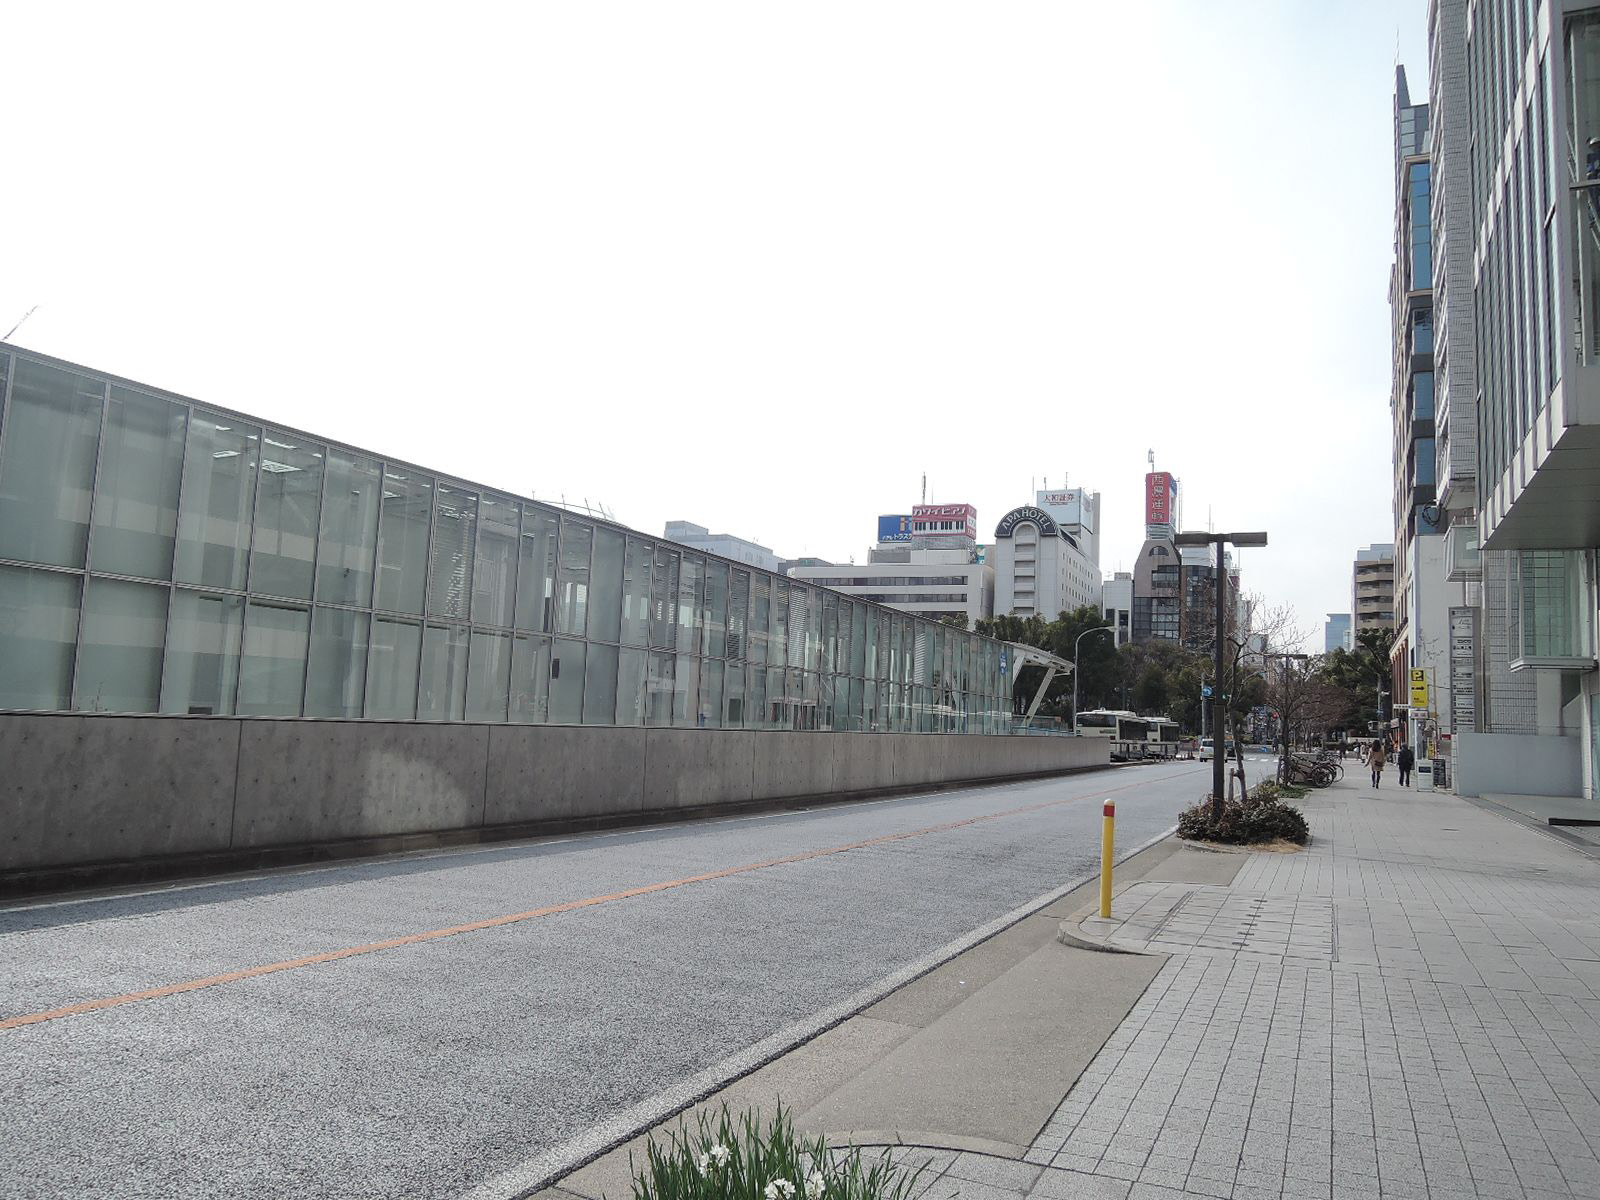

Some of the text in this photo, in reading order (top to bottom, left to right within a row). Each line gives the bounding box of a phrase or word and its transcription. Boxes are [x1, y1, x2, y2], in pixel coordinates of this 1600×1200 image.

[913, 506, 966, 516] カワイピアノ
[1002, 509, 1051, 530] APA HOTEL
[1412, 671, 1422, 680] P
